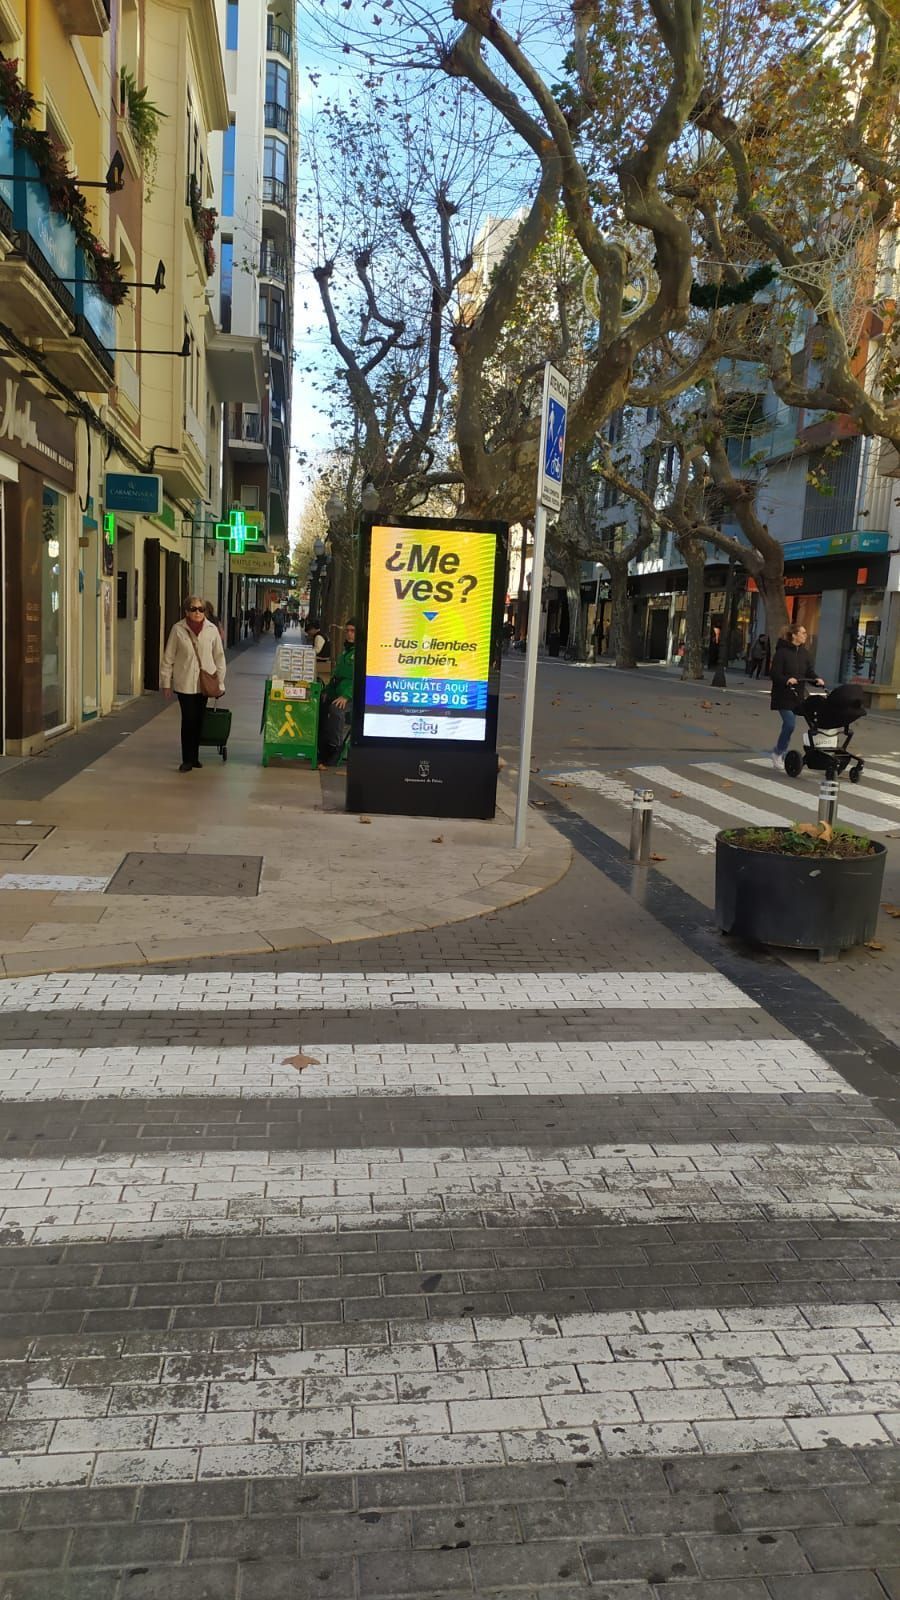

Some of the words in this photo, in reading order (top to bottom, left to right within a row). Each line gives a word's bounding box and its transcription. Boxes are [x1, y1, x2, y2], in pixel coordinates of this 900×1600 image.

[385, 543, 460, 575] ¿Me
[394, 574, 478, 603] ves?
[422, 638, 478, 652] clientes
[398, 653, 458, 667] también.
[384, 691, 409, 703] 965
[412, 693, 428, 704] 22
[432, 693, 449, 705] 99
[451, 694, 468, 705] 06
[411, 718, 438, 735] city
